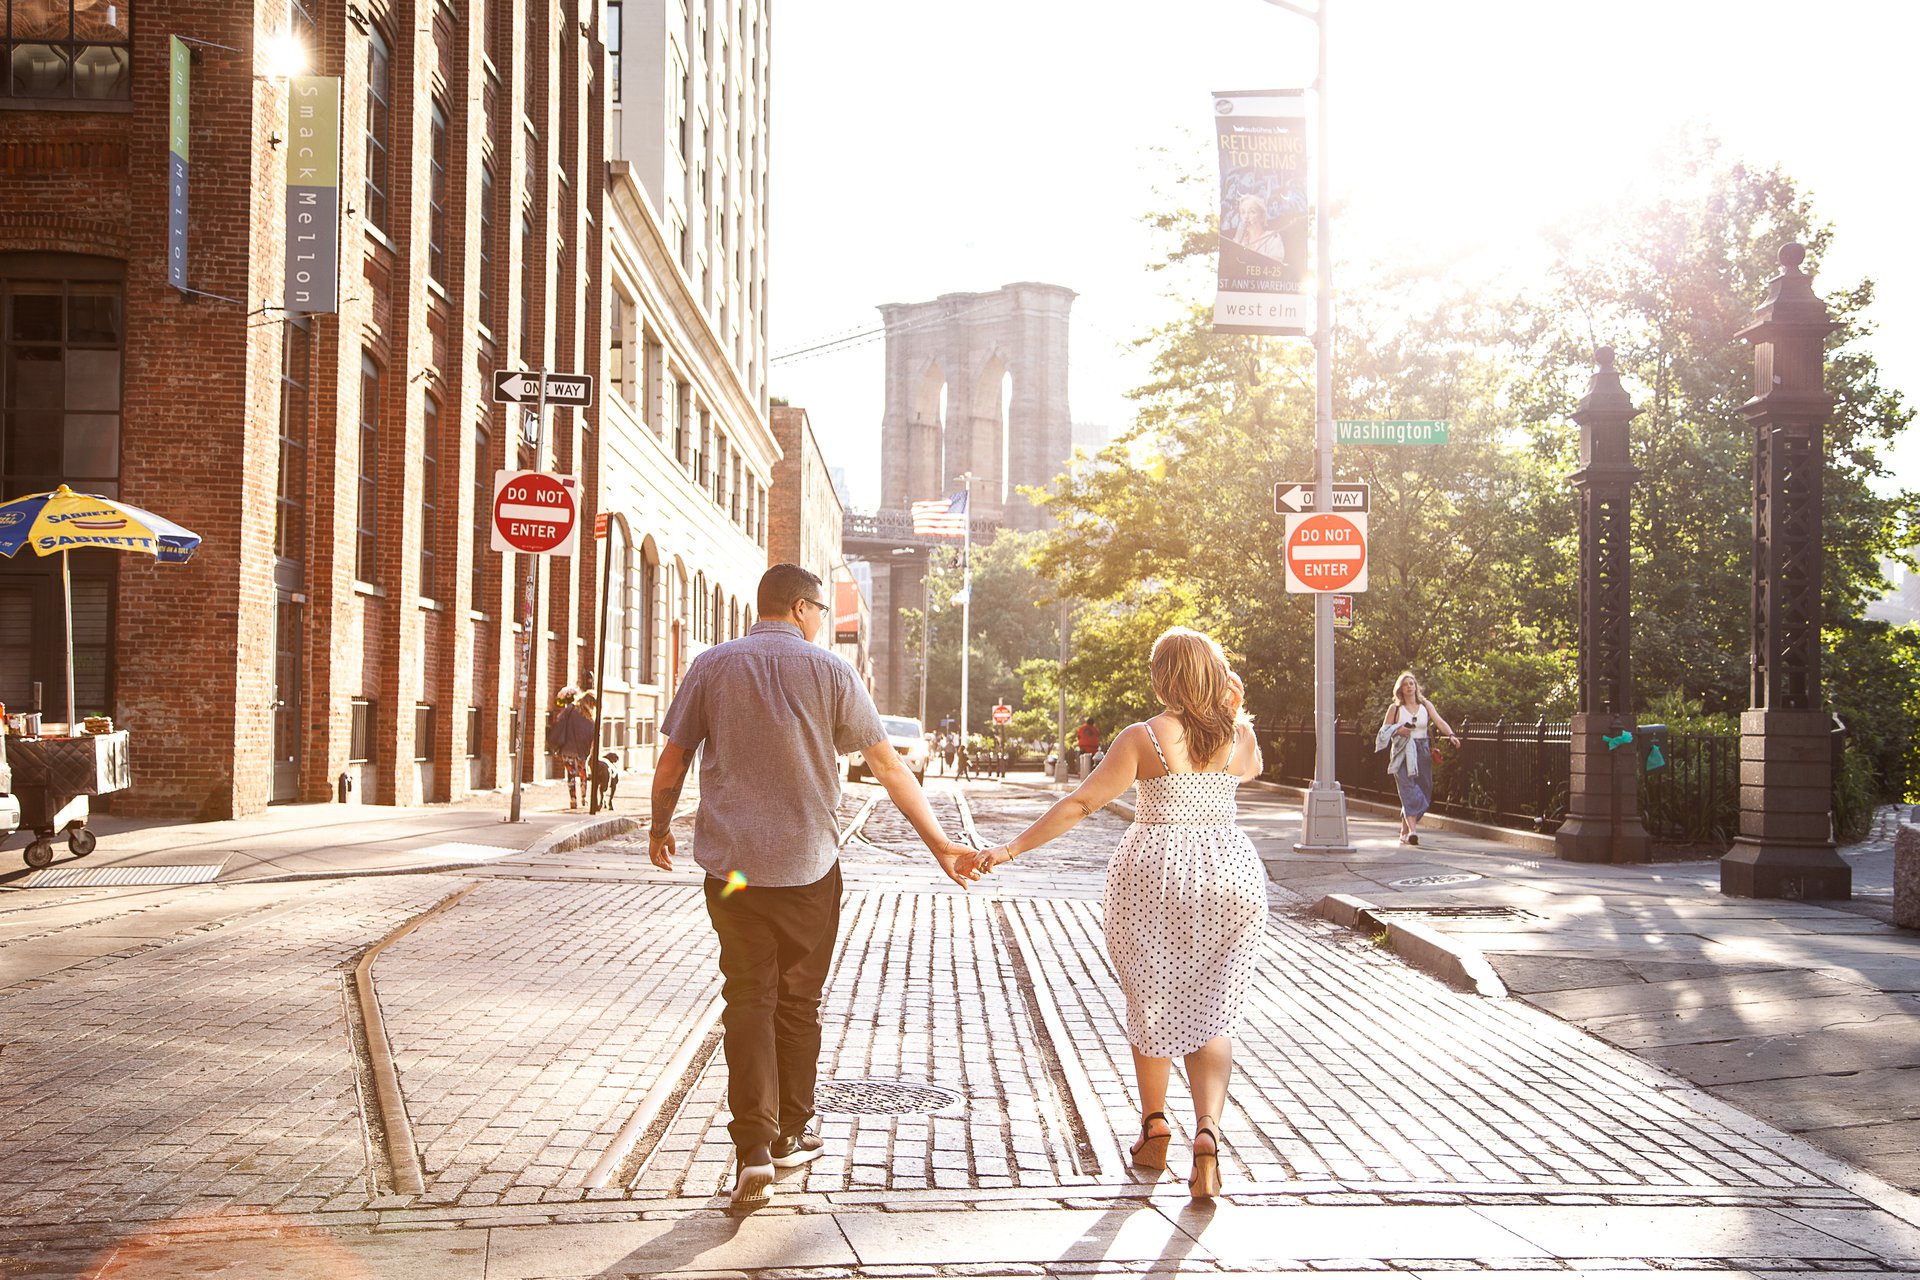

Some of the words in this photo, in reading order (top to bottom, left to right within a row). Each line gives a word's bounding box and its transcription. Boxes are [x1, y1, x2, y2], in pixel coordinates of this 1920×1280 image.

[176, 50, 185, 150] Smack
[299, 86, 318, 179] Smack
[1220, 134, 1304, 154] RETURNING
[1229, 150, 1249, 168] TO
[1253, 151, 1297, 171] REIMS
[173, 163, 184, 280] Mellon
[295, 192, 317, 303] Mellon
[1246, 265, 1261, 276] FEB
[1262, 266, 1282, 277] 4-25
[1256, 280, 1304, 292] WAREHOU
[1226, 302, 1263, 317] west
[1269, 303, 1297, 319] elm
[554, 383, 581, 397] WAY
[1339, 422, 1432, 443] Washington
[1434, 421, 1445, 432] St
[507, 487, 527, 501] DO
[536, 489, 564, 504] NOT
[1333, 493, 1359, 505] WAY
[46, 509, 117, 524] SABRETT
[510, 522, 556, 539] ENTER
[1301, 529, 1319, 542] DO
[1325, 528, 1351, 542] NOT
[39, 535, 152, 550] SABRETT
[1304, 563, 1348, 577] ENTER
